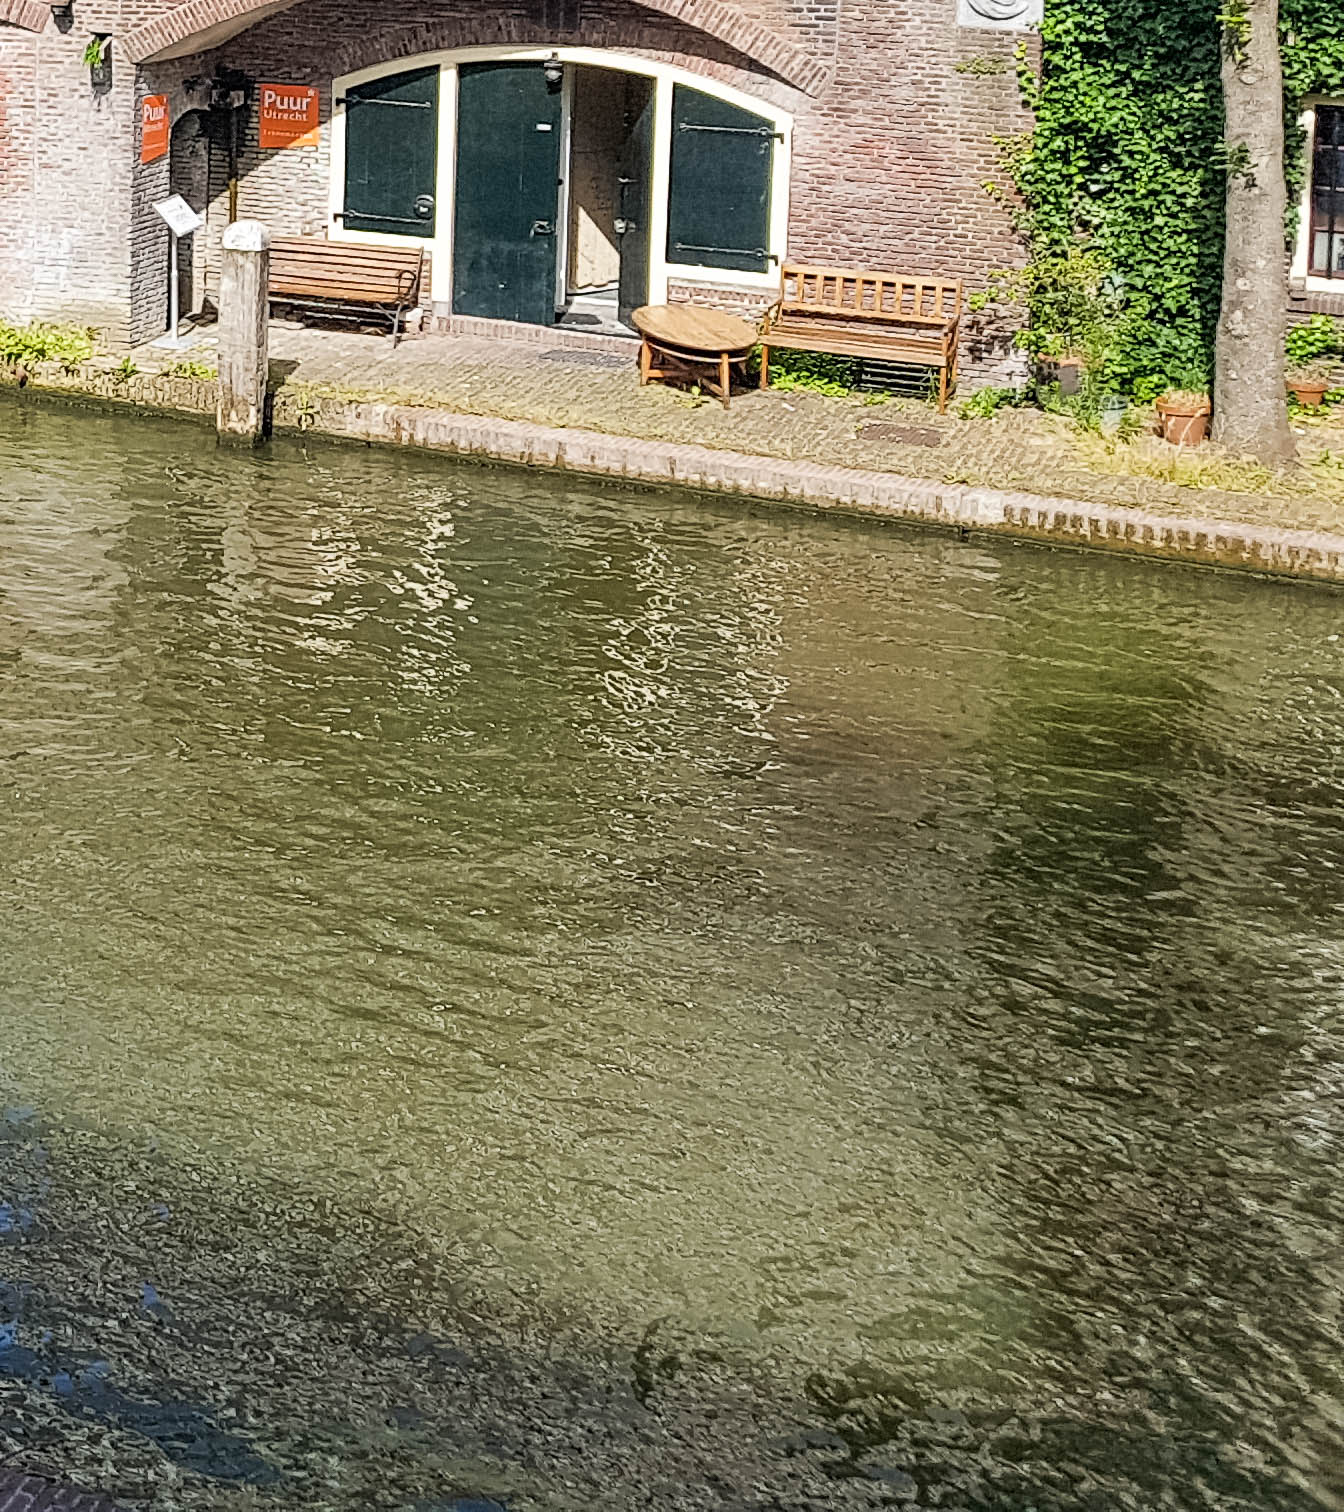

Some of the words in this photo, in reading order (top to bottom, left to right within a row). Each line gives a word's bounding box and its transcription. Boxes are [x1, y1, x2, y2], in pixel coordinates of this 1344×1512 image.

[263, 89, 311, 111] Puur
[143, 104, 166, 123] Puur
[263, 109, 308, 122] Utrecht
